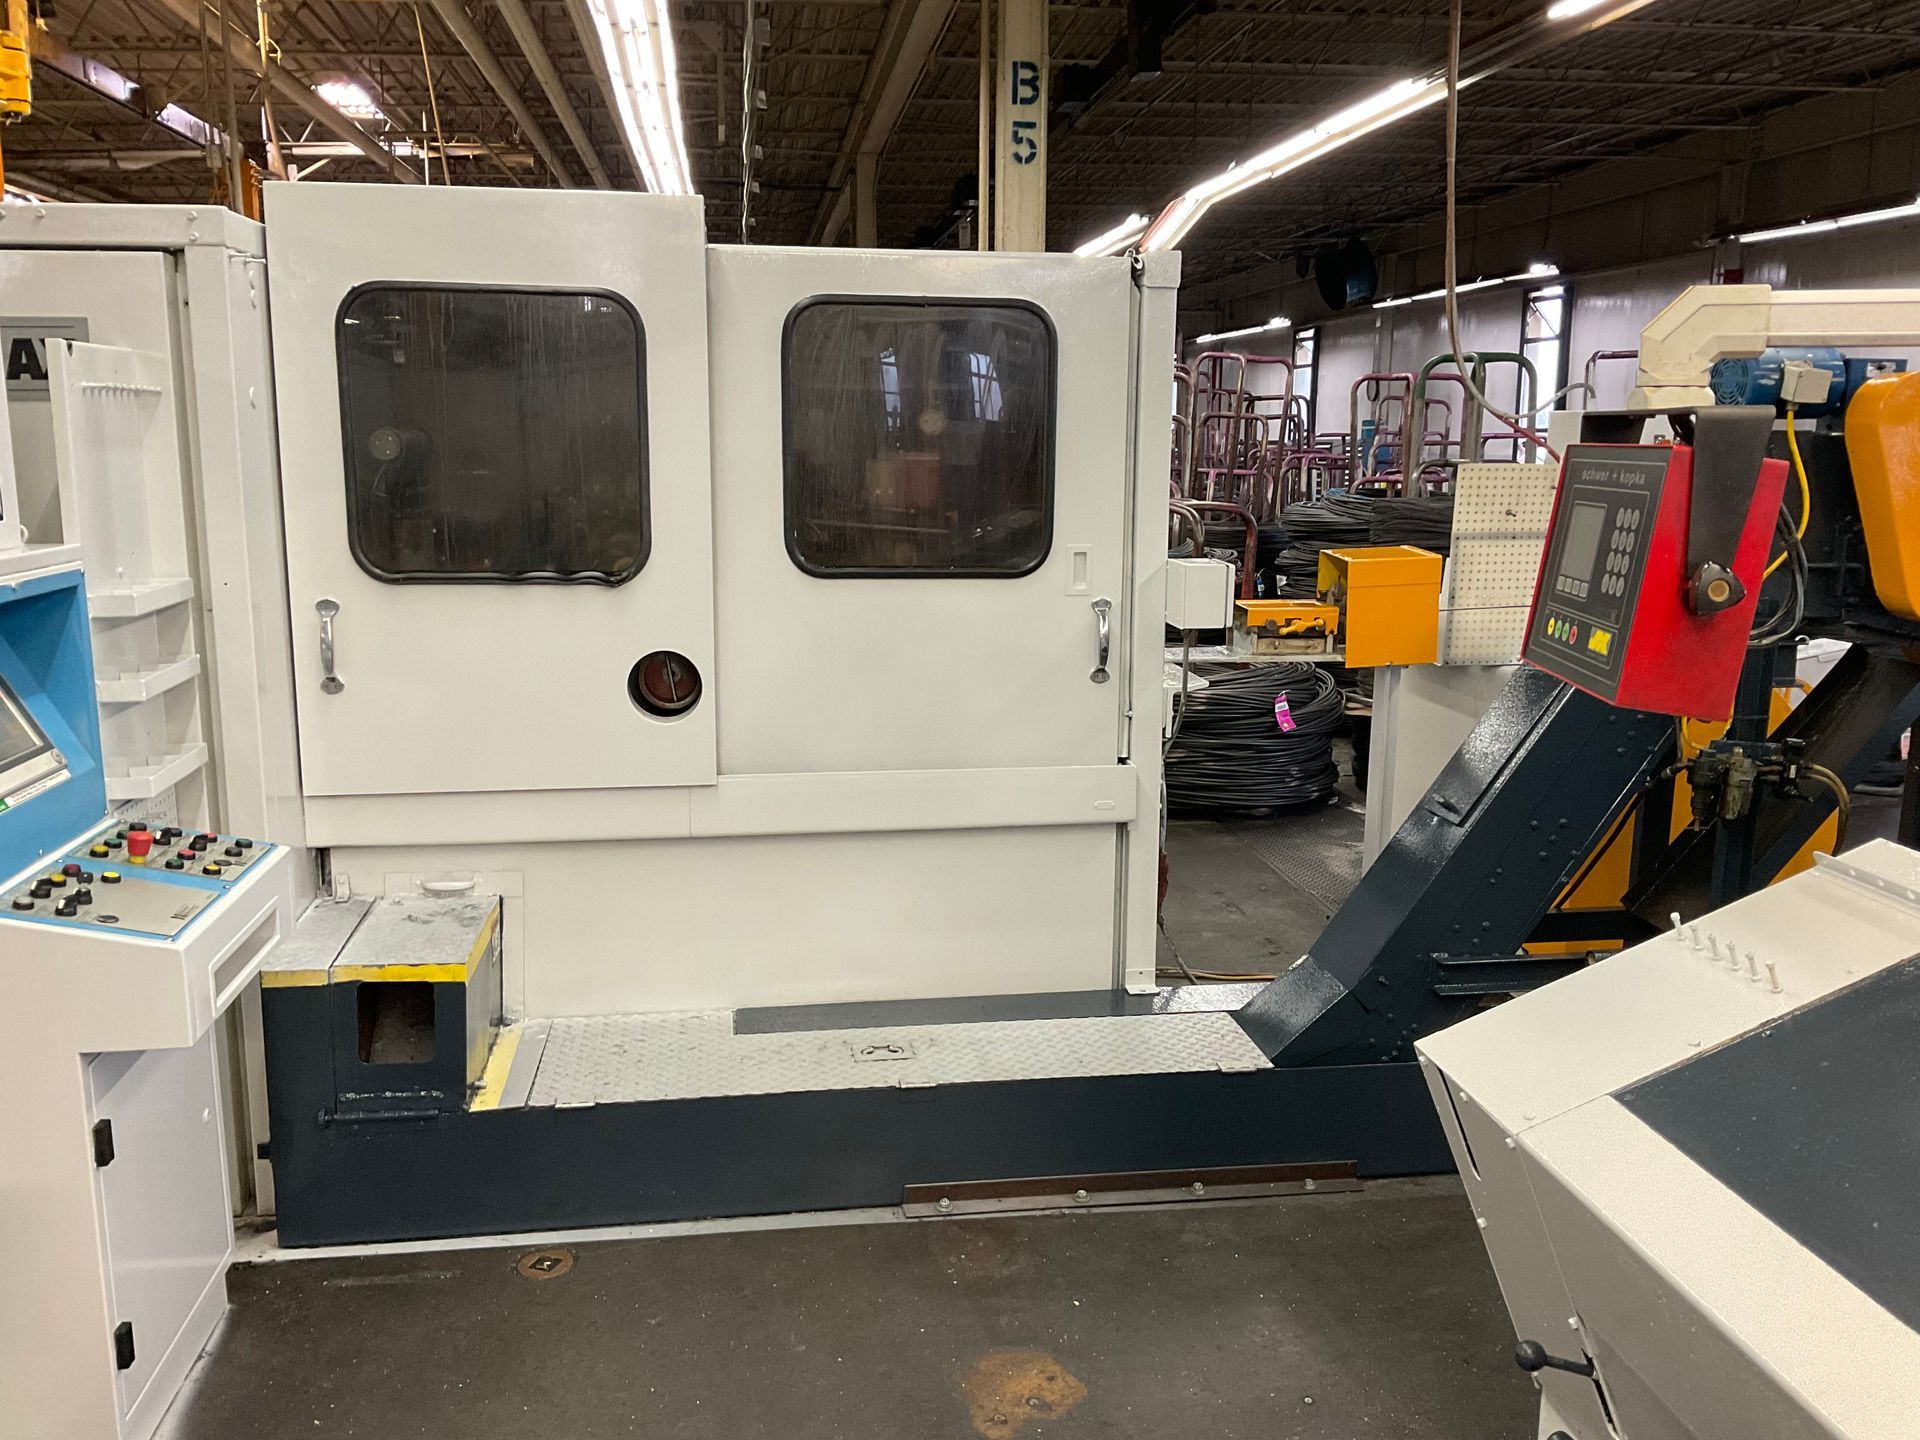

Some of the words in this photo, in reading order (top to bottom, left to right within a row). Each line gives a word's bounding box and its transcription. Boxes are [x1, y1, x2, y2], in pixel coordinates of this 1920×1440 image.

[1012, 61, 1040, 105] B
[1012, 121, 1038, 165] 5
[1619, 470, 1646, 487] kopka
